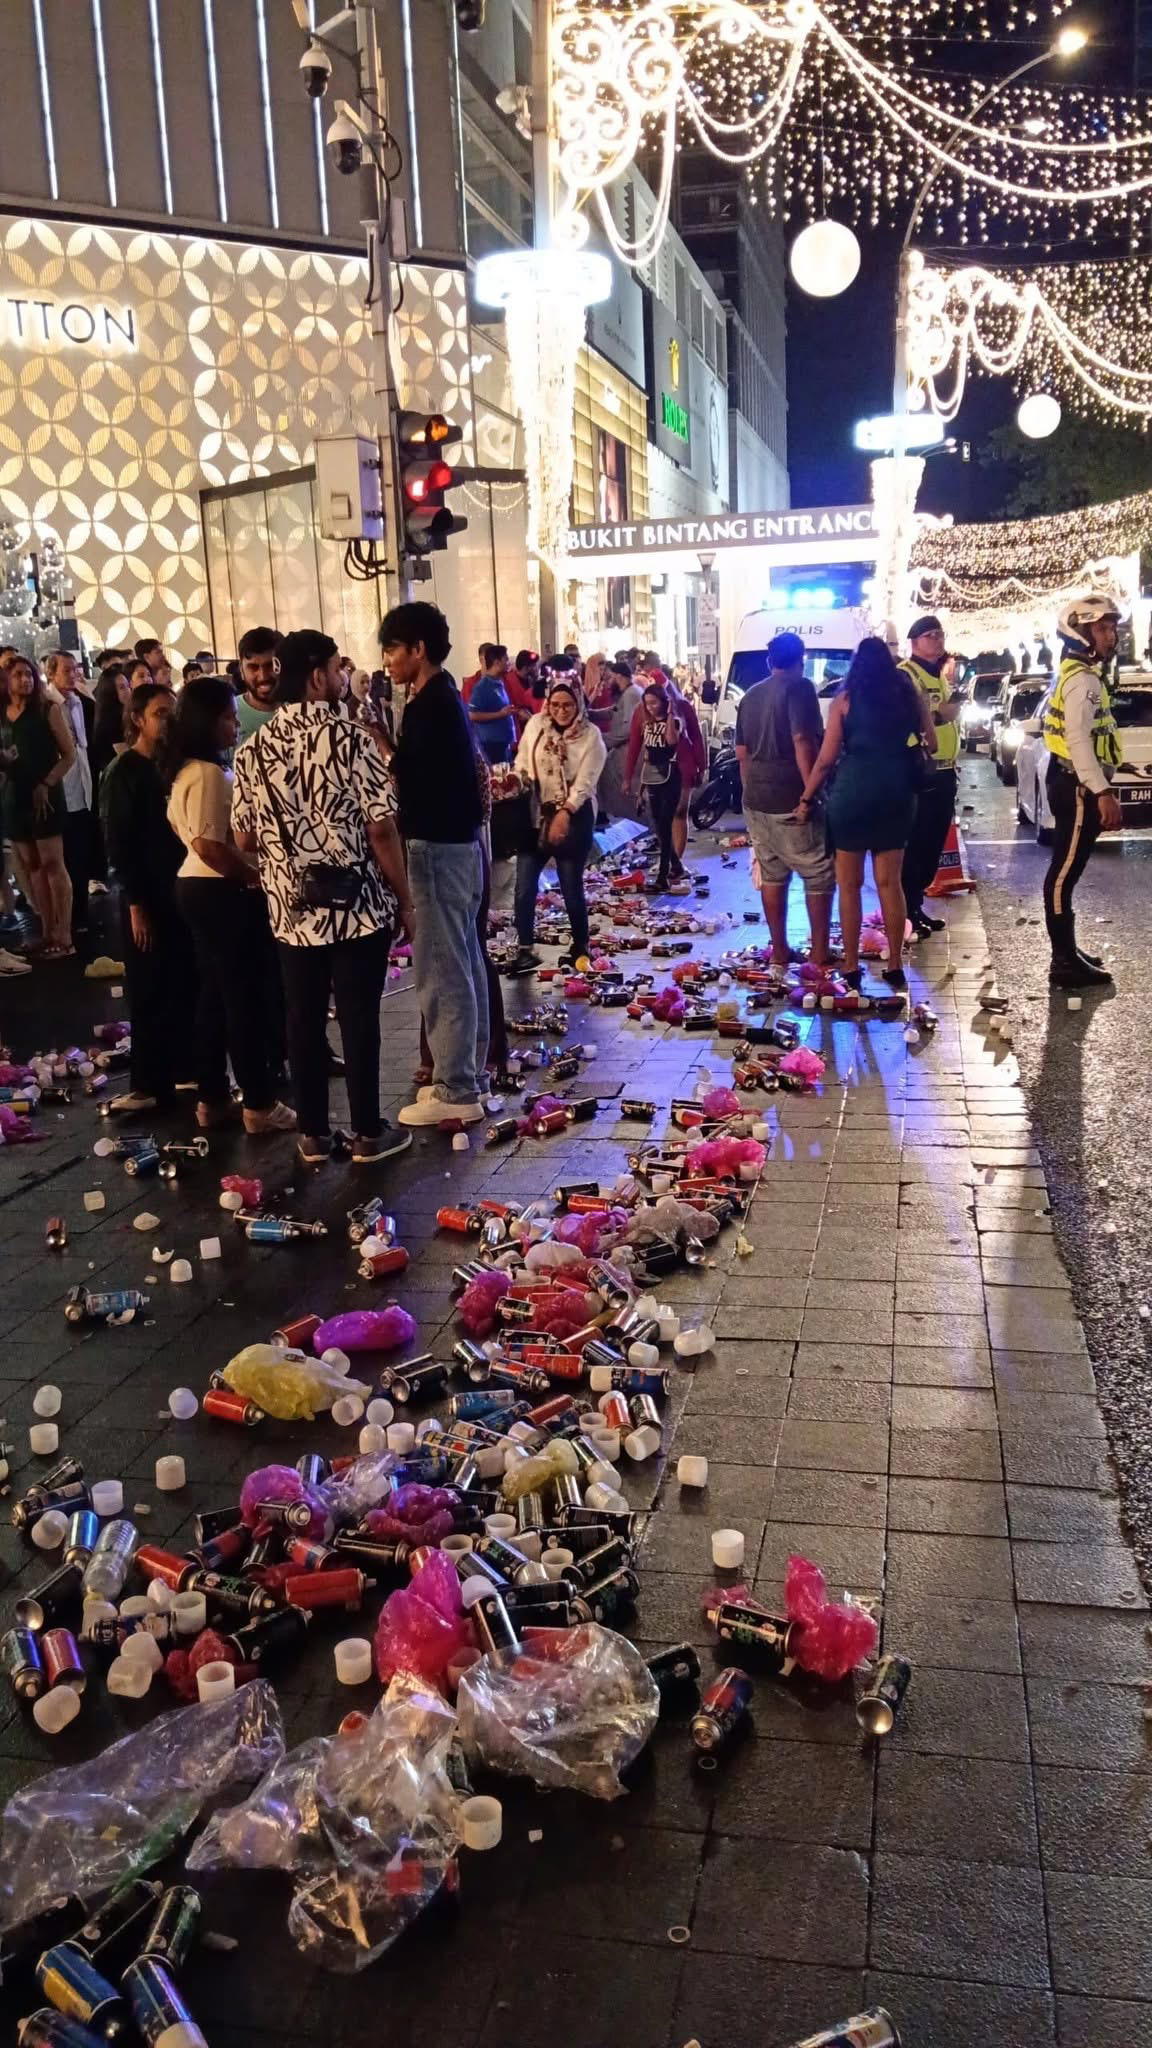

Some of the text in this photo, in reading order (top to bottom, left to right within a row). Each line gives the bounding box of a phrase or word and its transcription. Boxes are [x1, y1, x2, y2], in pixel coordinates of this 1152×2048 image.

[8, 299, 134, 344] TTON
[568, 527, 636, 549] BUKIT
[643, 519, 748, 545] BINTANG
[775, 626, 823, 635] POLIS
[1131, 790, 1151, 800] RAH
